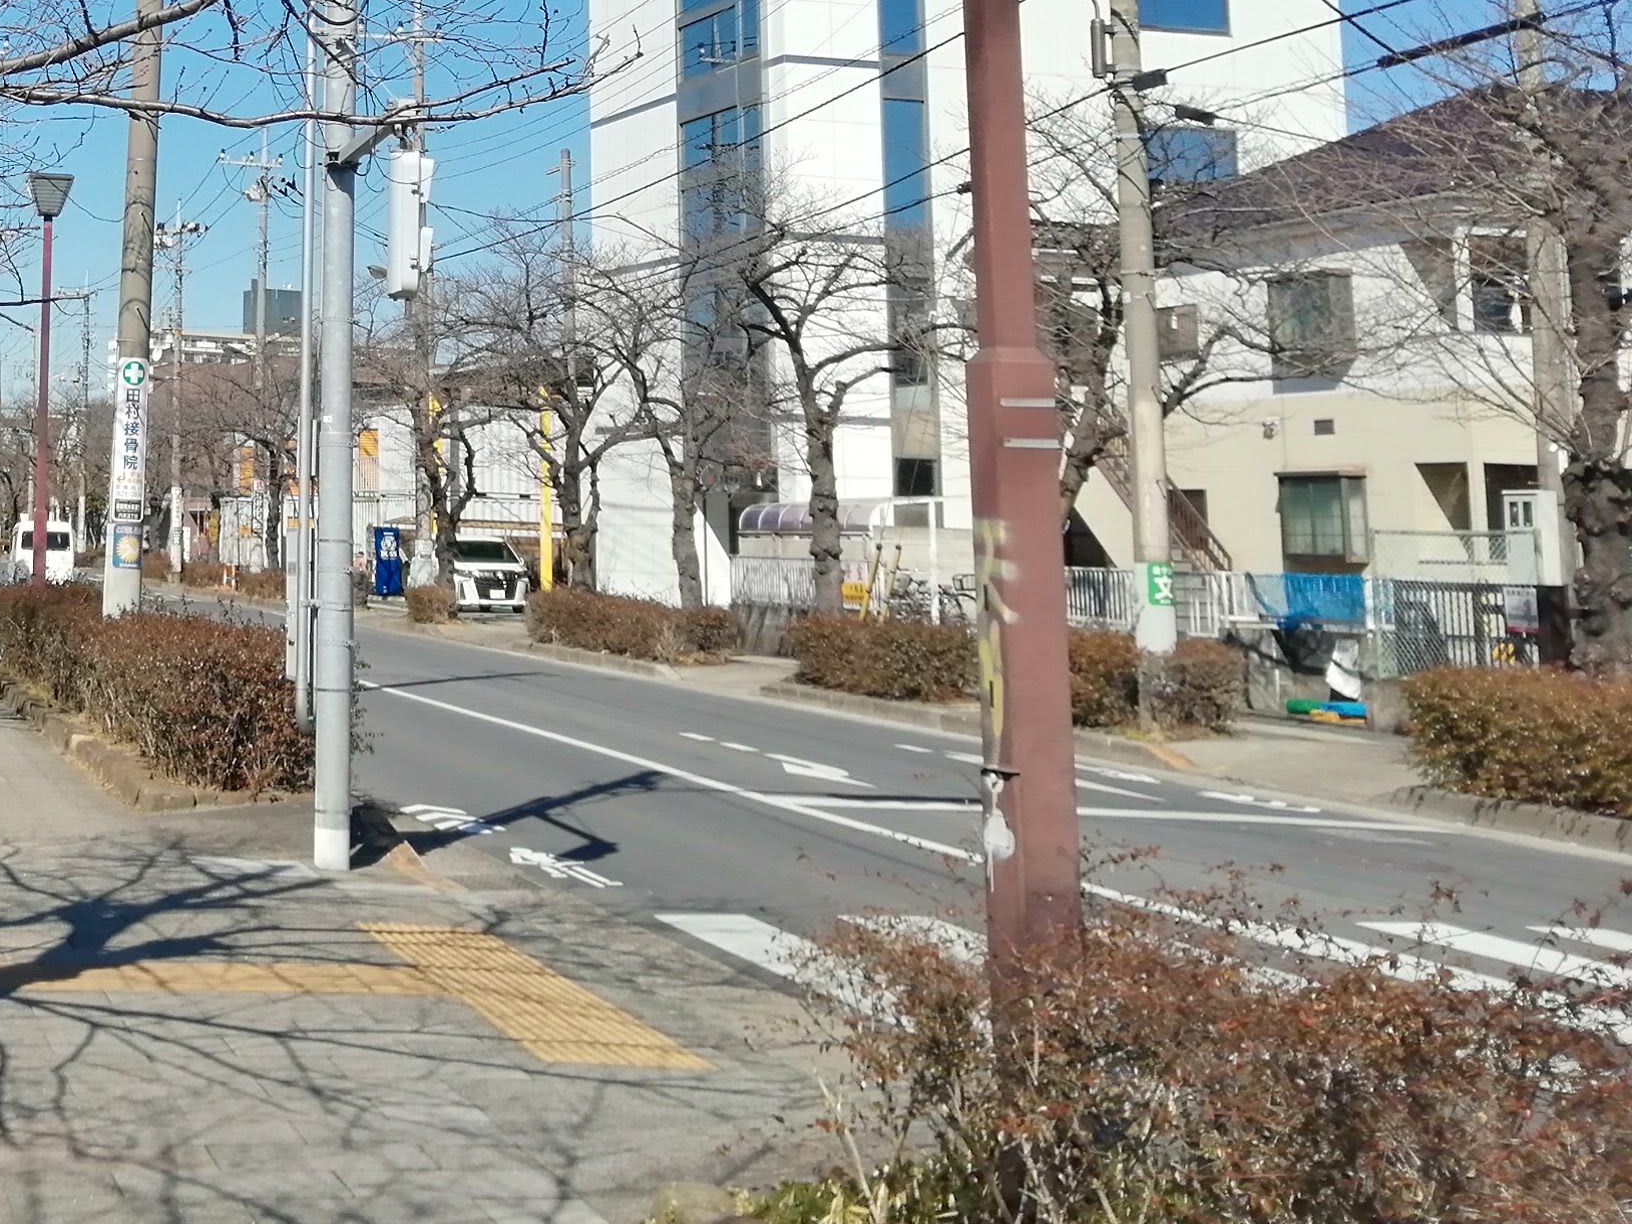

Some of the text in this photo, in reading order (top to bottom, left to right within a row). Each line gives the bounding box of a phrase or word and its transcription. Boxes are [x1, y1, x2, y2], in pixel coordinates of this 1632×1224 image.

[123, 388, 141, 470] 田村接骨院
